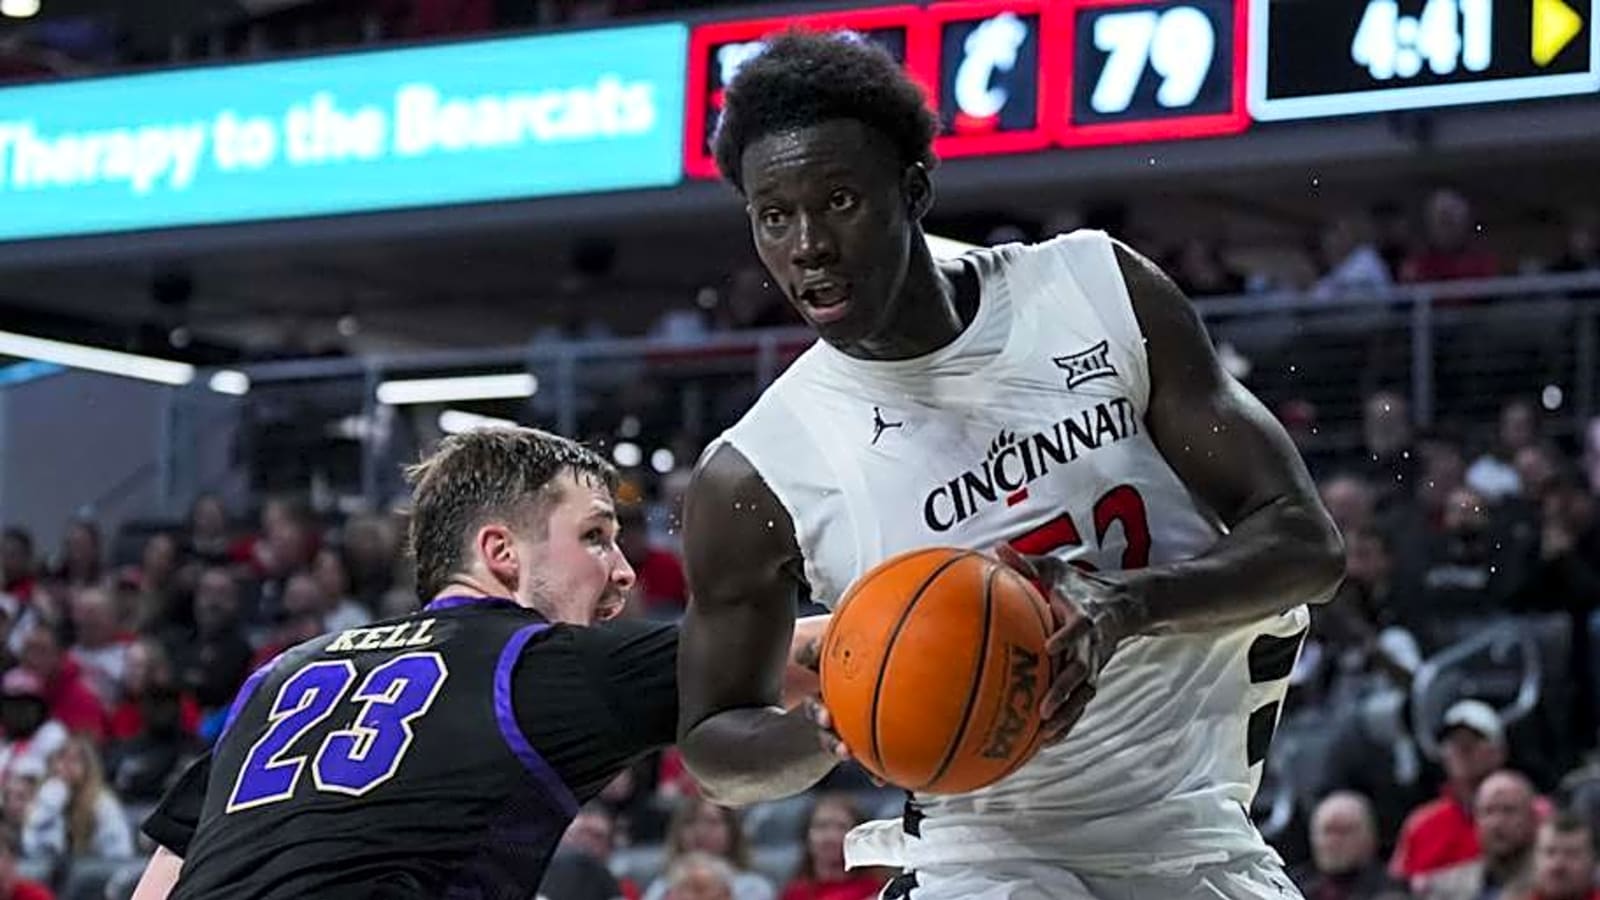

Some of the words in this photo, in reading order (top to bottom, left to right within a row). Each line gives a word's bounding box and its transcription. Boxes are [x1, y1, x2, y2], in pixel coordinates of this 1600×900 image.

[1090, 5, 1215, 113] 79
[1351, 0, 1492, 80] 4:41
[210, 110, 277, 171] to
[284, 93, 386, 165] the
[394, 73, 656, 156] Bearcats
[325, 618, 436, 652] KELL
[225, 652, 449, 814] 23
[983, 643, 1040, 760] NCAA
